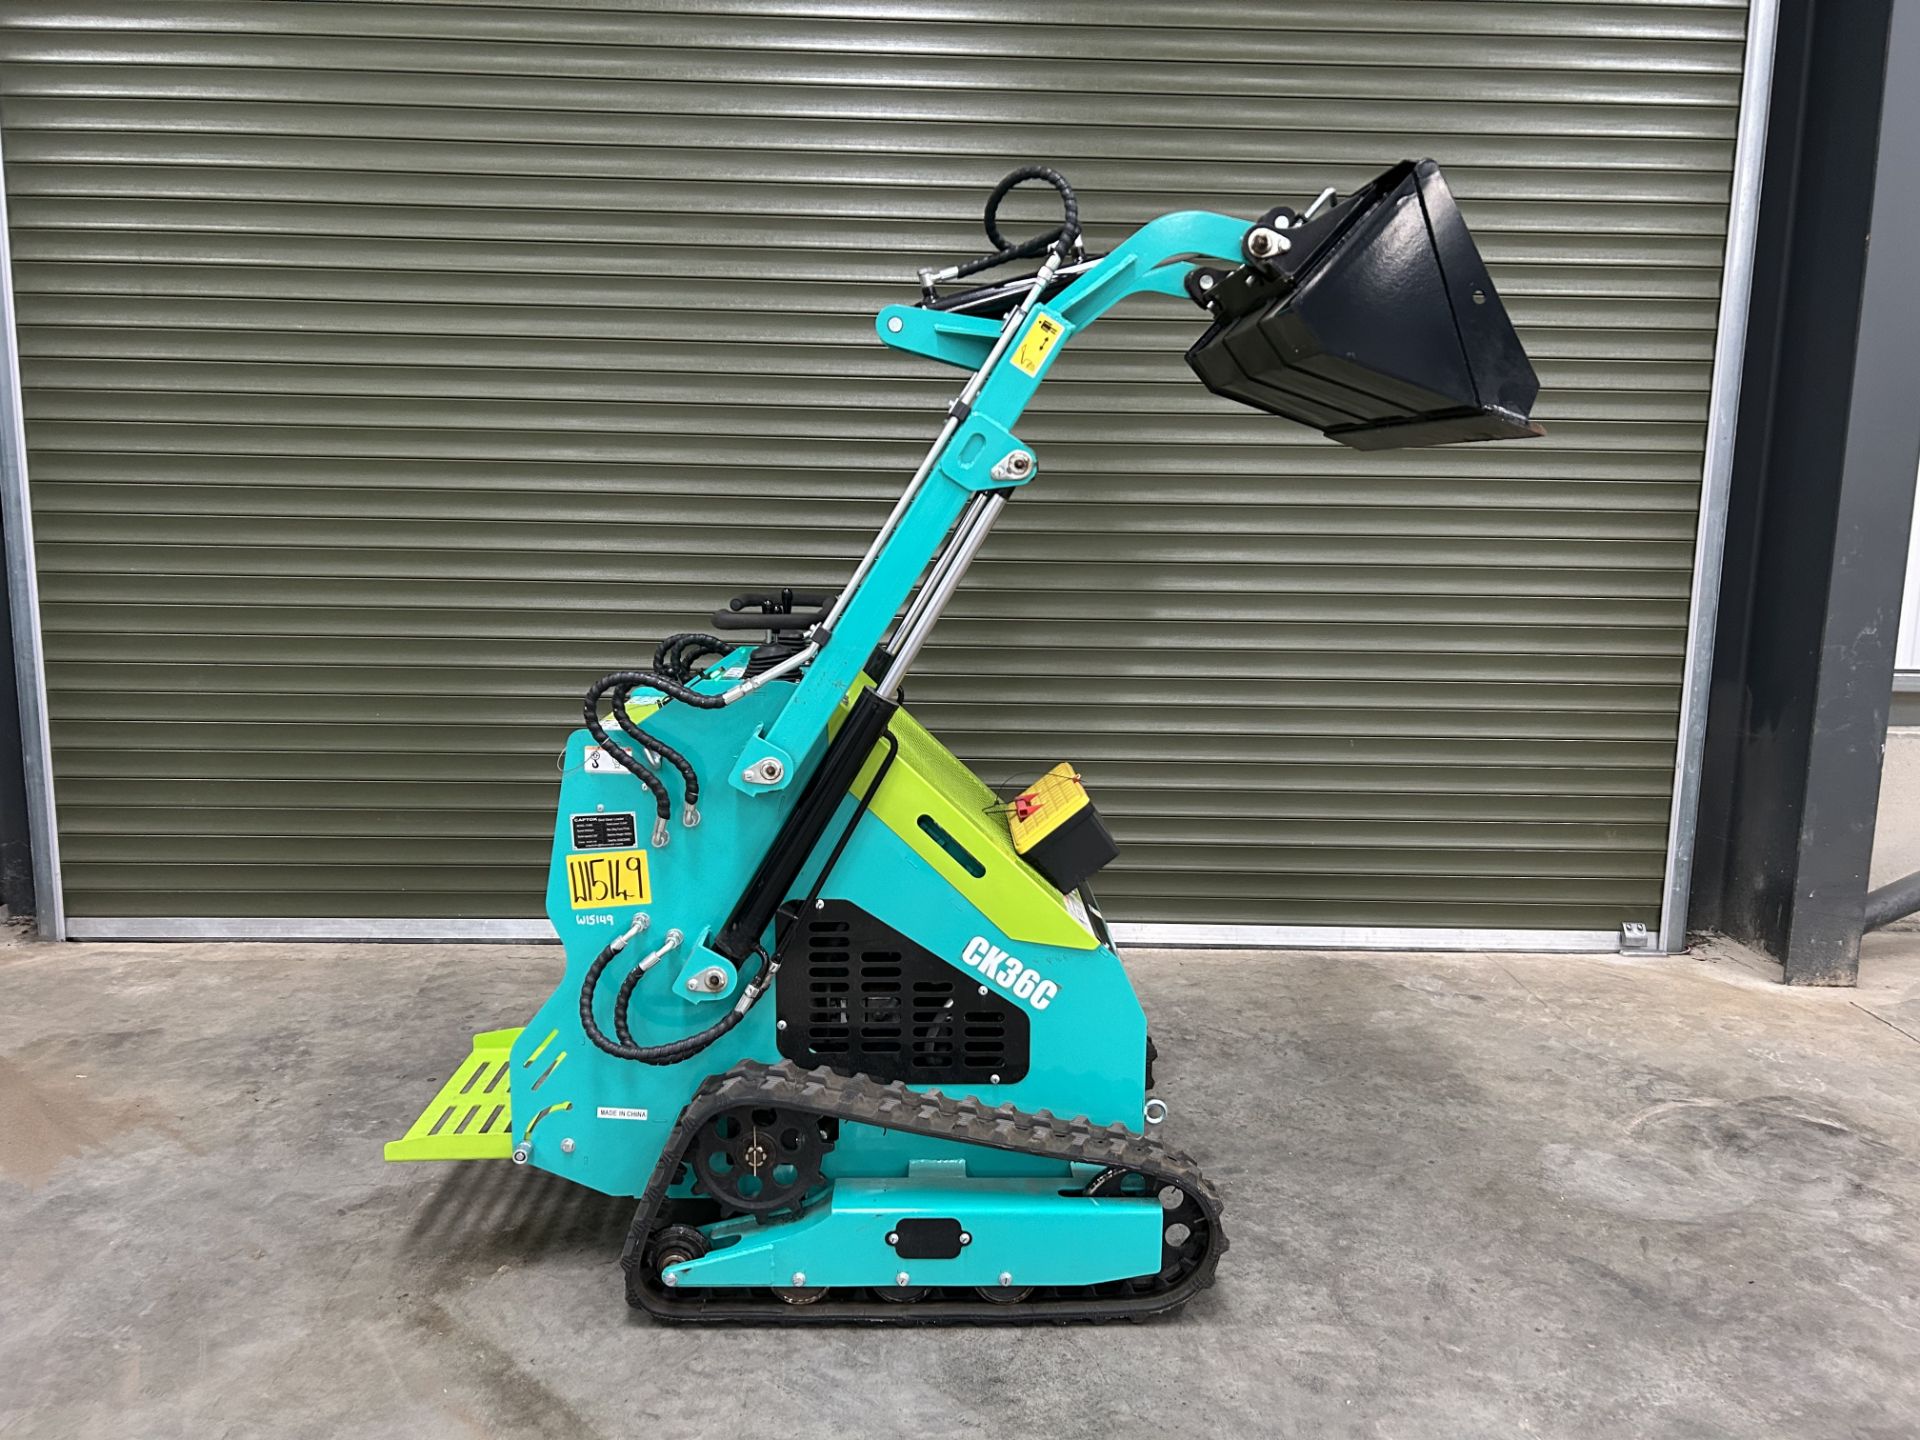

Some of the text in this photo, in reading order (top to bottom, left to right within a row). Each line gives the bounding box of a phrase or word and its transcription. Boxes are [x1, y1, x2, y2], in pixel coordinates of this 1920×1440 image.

[570, 857, 643, 903] W15149
[576, 914, 614, 926] W15149
[962, 936, 1058, 1010] CK36C
